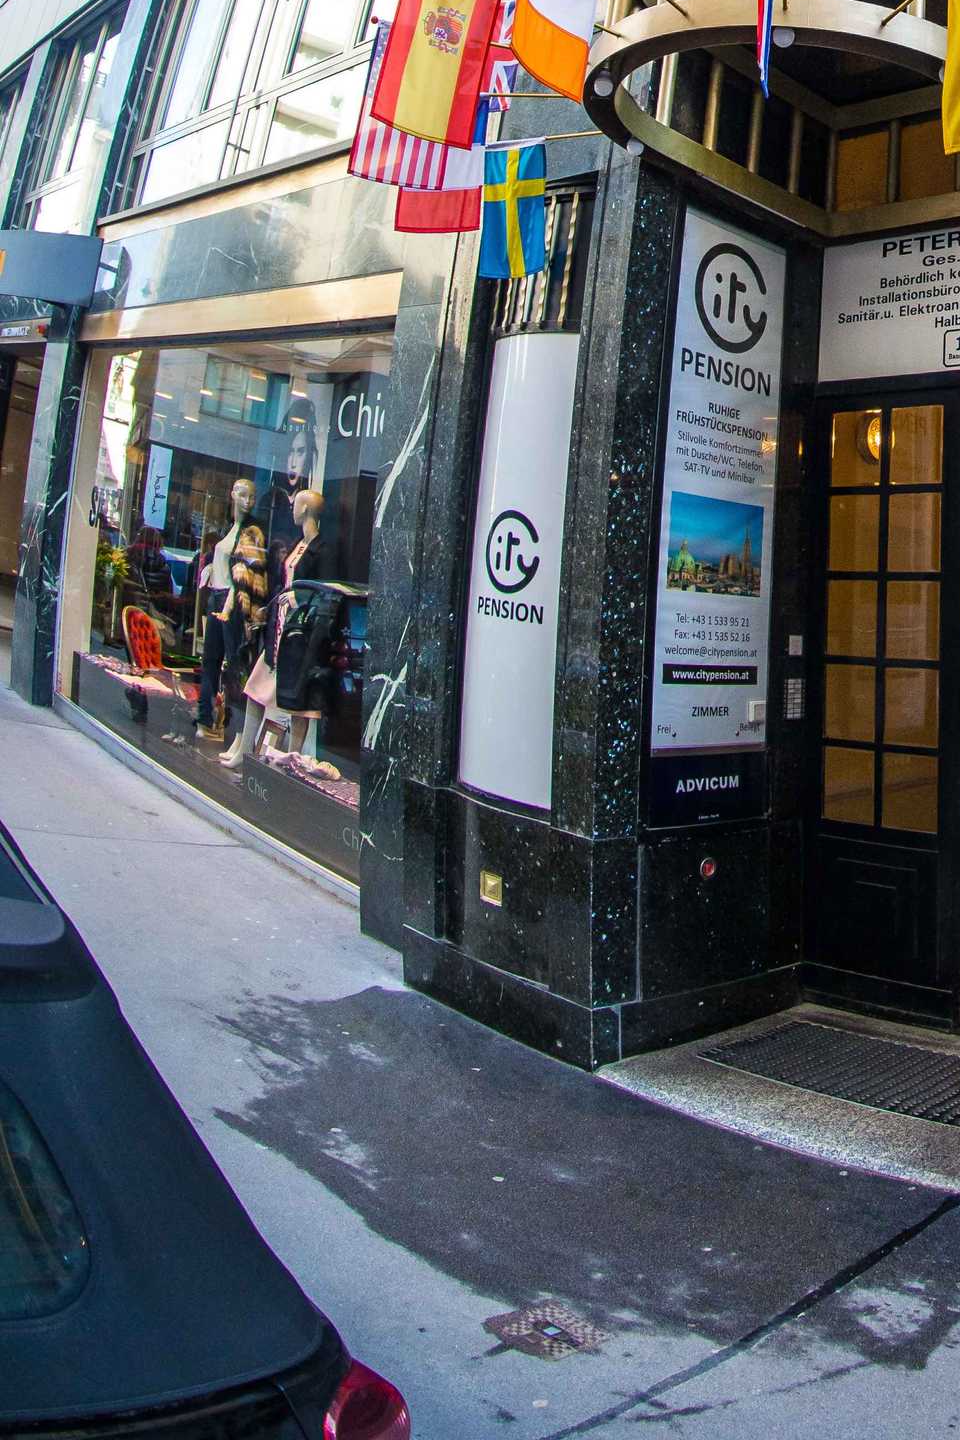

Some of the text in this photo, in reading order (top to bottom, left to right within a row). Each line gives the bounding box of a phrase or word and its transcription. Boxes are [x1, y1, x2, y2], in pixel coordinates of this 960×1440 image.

[880, 270, 944, 289] Behördlich
[858, 285, 960, 306] Installationsbüro
[680, 347, 771, 397] PENSION
[708, 402, 741, 420] RUHIGE
[676, 410, 768, 441] FRÜHSTÜCKSPENSION
[678, 431, 707, 446] Stilvolle
[676, 446, 689, 456] mit
[684, 461, 755, 484] SAT-TV und Minibar
[478, 596, 544, 624] PENSION
[691, 615, 705, 625] +43
[692, 631, 706, 640] +43
[664, 645, 757, 658] welcome@citypension.at
[672, 669, 749, 681] www.citypension.at
[691, 706, 729, 717] ZIMMER
[657, 724, 672, 734] Frei
[675, 775, 739, 793] ADVICUM
